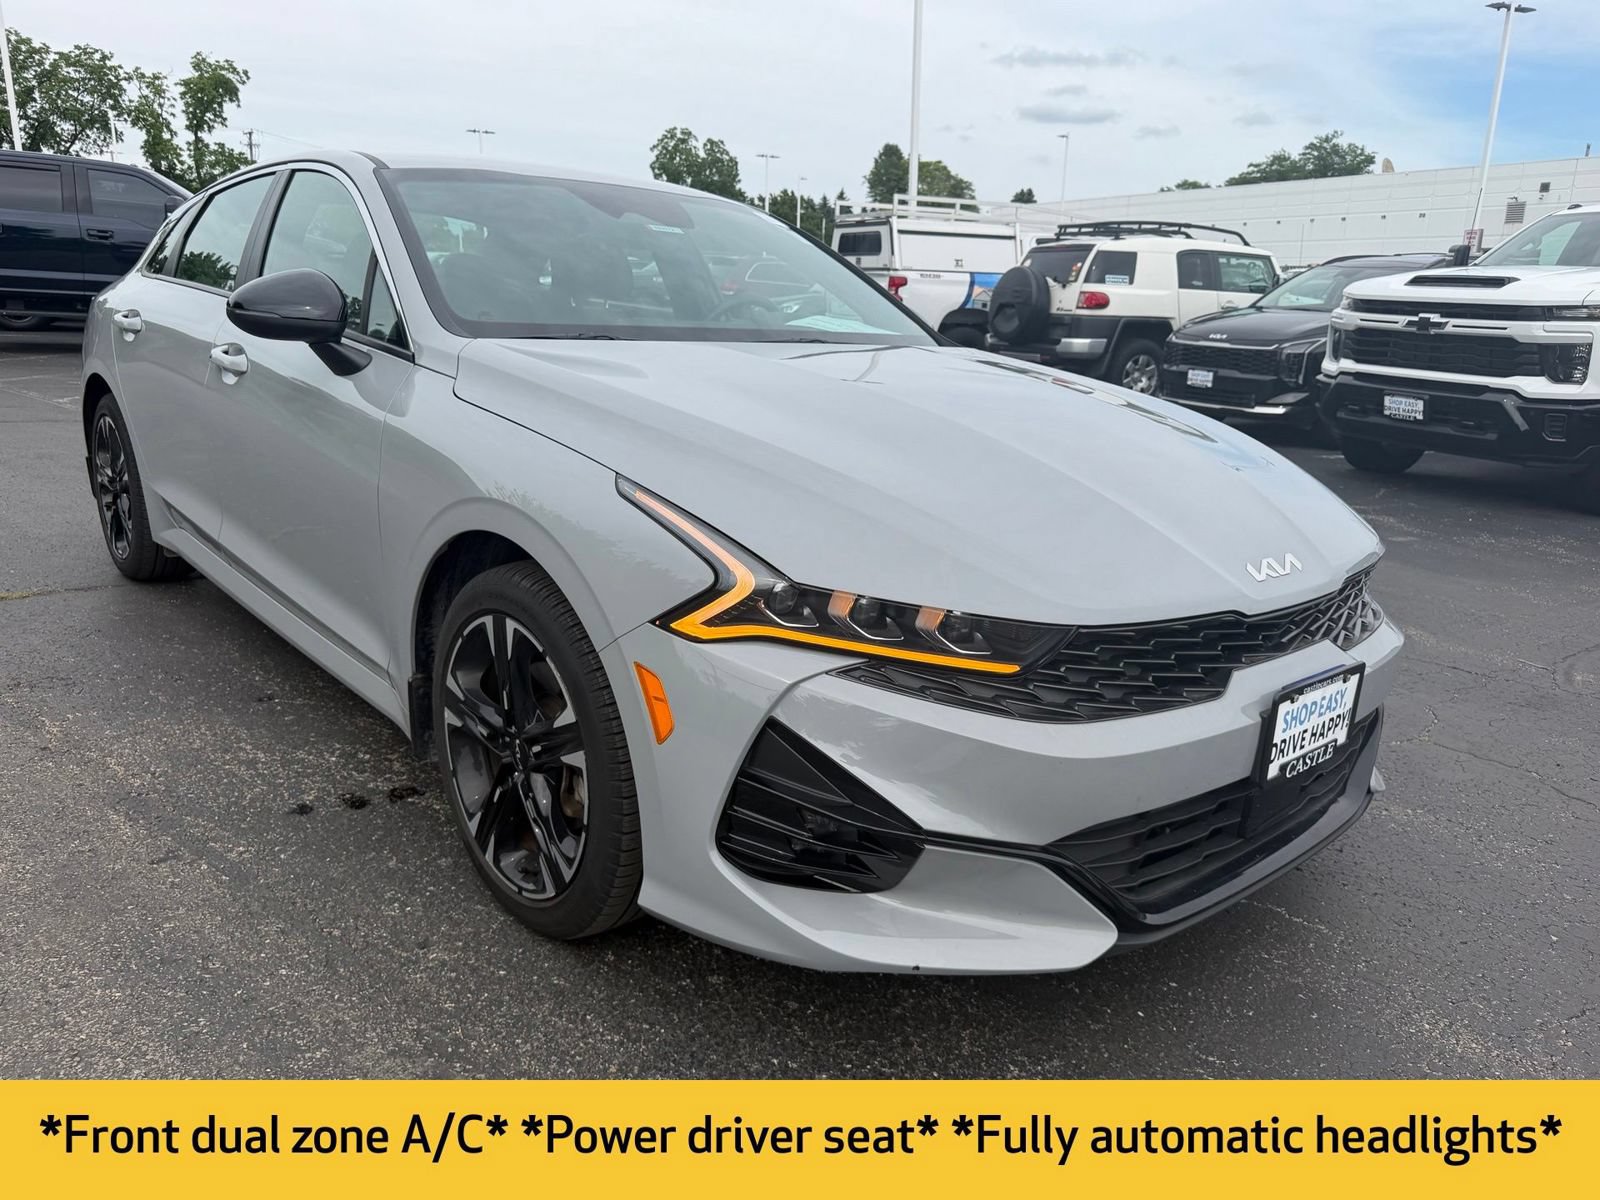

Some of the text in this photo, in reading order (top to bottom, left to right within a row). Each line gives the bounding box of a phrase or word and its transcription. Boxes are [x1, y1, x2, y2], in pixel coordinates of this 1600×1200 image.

[1245, 552, 1302, 582] KIA
[1282, 687, 1348, 733] SHOP EASY,
[1270, 707, 1351, 765] DRIVE HAPPY!
[1286, 741, 1334, 778] CASTLE
